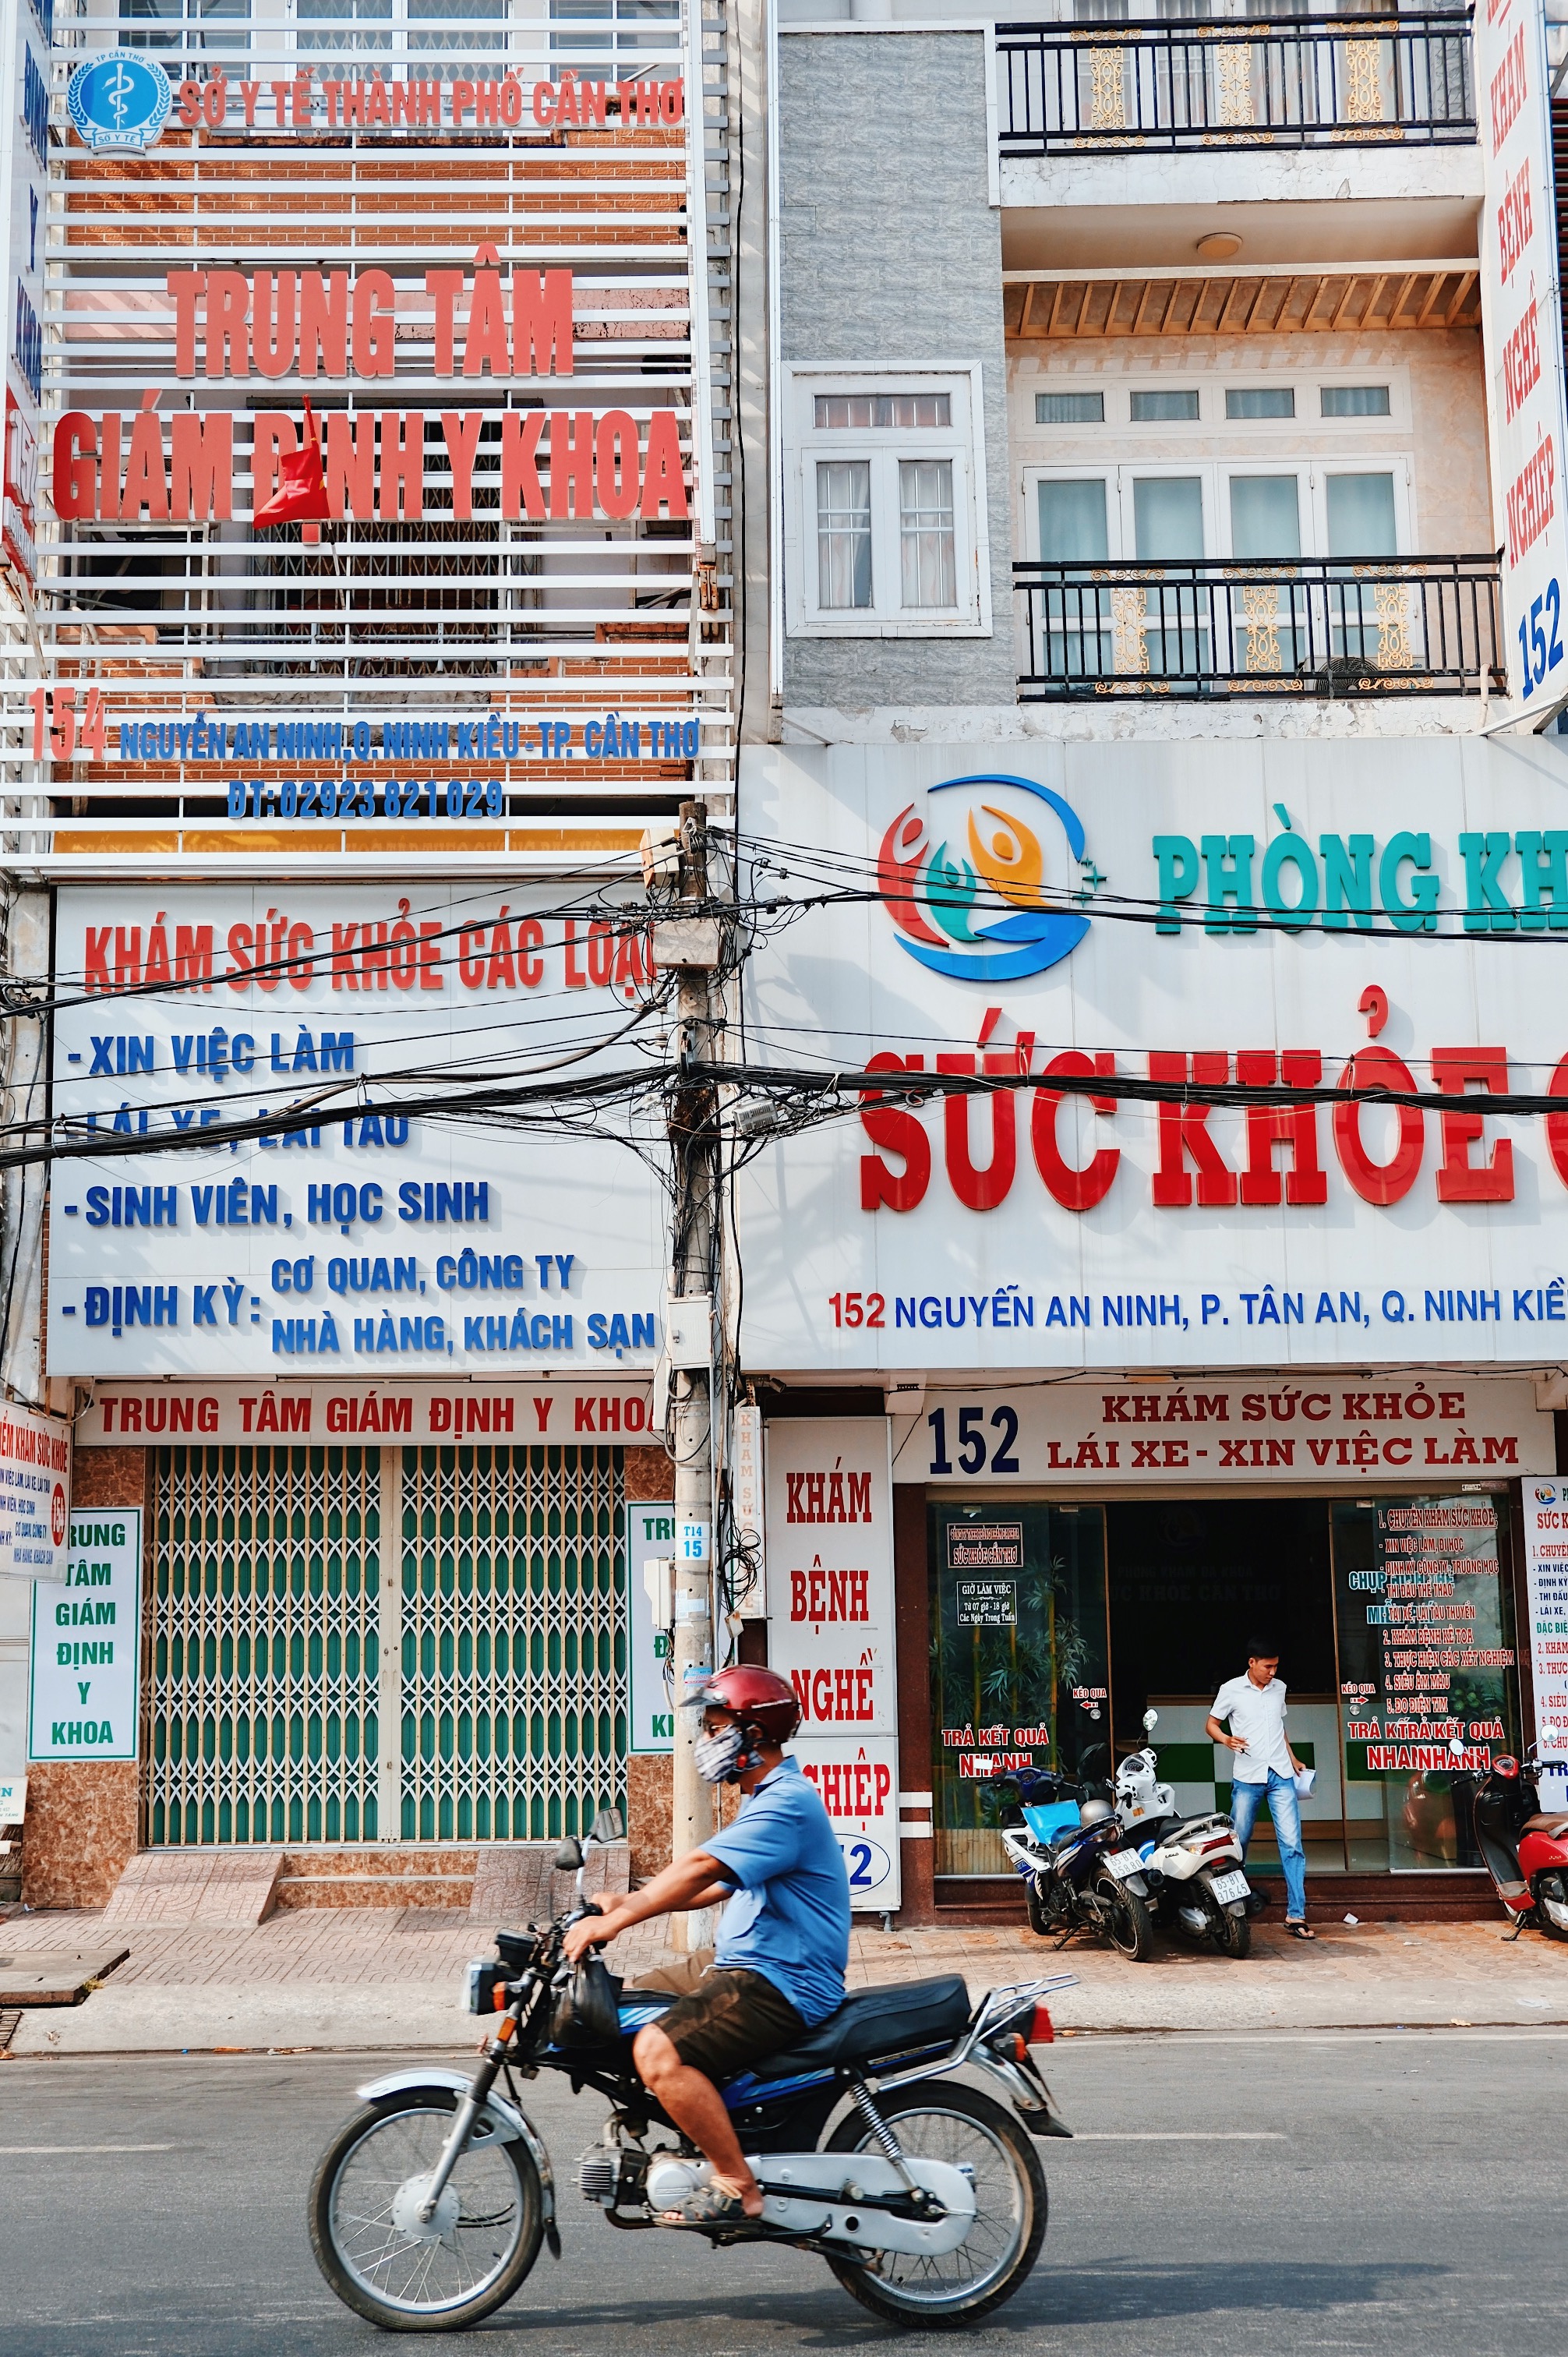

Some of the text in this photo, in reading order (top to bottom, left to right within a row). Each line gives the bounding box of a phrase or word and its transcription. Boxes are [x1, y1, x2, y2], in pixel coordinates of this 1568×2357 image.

[95, 53, 107, 63] TP
[178, 65, 685, 127] SỞ Y TẾ THÀNH PHỐ CẦN THƠ
[114, 134, 122, 143] Y
[168, 242, 574, 380] TRUNG TÂM
[53, 388, 234, 522] GIÁM
[440, 412, 484, 521] Y
[502, 409, 690, 521] KHOA
[1517, 578, 1564, 701] 152
[29, 687, 107, 761] 154
[234, 722, 270, 760] AN
[383, 721, 450, 759] NINH
[457, 711, 520, 759] KIỀU
[584, 711, 640, 759] CẦN
[648, 716, 701, 759] THƠ
[1153, 803, 1440, 935] PHÒNG
[85, 898, 546, 995] KHÁM SỨC KHỎE CÁC
[171, 1023, 355, 1083] VIỆC LÀM
[860, 1006, 1121, 1212] SỨC
[1147, 984, 1515, 1206] KHỎE
[191, 1176, 489, 1235] VIÊN, HỌC SINH
[271, 1247, 576, 1297] CƠ QUAN, CÔNG TY
[828, 1285, 1513, 1331] 152 NGUYỄN AN NINH, P. TÂN AN, Q. NINH
[273, 1307, 655, 1359] NHÀ HÀNG, KHÁCH SẠN
[99, 1396, 219, 1434] TRUNG
[238, 1390, 312, 1433] TÂM
[326, 1389, 413, 1433] GIÁM
[429, 1397, 514, 1441] ĐỊNH
[532, 1398, 554, 1433] Y
[1101, 1380, 1467, 1423] KHÁM SỨC KHỎE
[927, 1405, 1020, 1475] 152
[1047, 1429, 1520, 1475] LÁI XE XIN VIỆC LÀM
[786, 1457, 872, 1524] KHÁM
[683, 1525, 702, 1537] T14
[1537, 1508, 1560, 1529] SỨC
[683, 1540, 702, 1558] 15
[1538, 1564, 1551, 1573] XIN
[790, 1554, 870, 1634] BỆNH
[962, 1583, 1012, 1596] GIỜ LÀM VIỆC
[1348, 1571, 1387, 1593] CHỤP
[1539, 1592, 1551, 1601] THI
[55, 1598, 116, 1626] GIÁM
[56, 1641, 114, 1670] ĐỊNH
[77, 1682, 91, 1705] Y
[1089, 1687, 1107, 1699] QUA
[1358, 1684, 1376, 1694] QUA
[51, 1721, 114, 1745] KHOA
[941, 1723, 1050, 1747] TRẢ KẾT QUẢ
[1347, 1716, 1381, 1740] TRẢ
[1469, 1716, 1505, 1741] QUẢ
